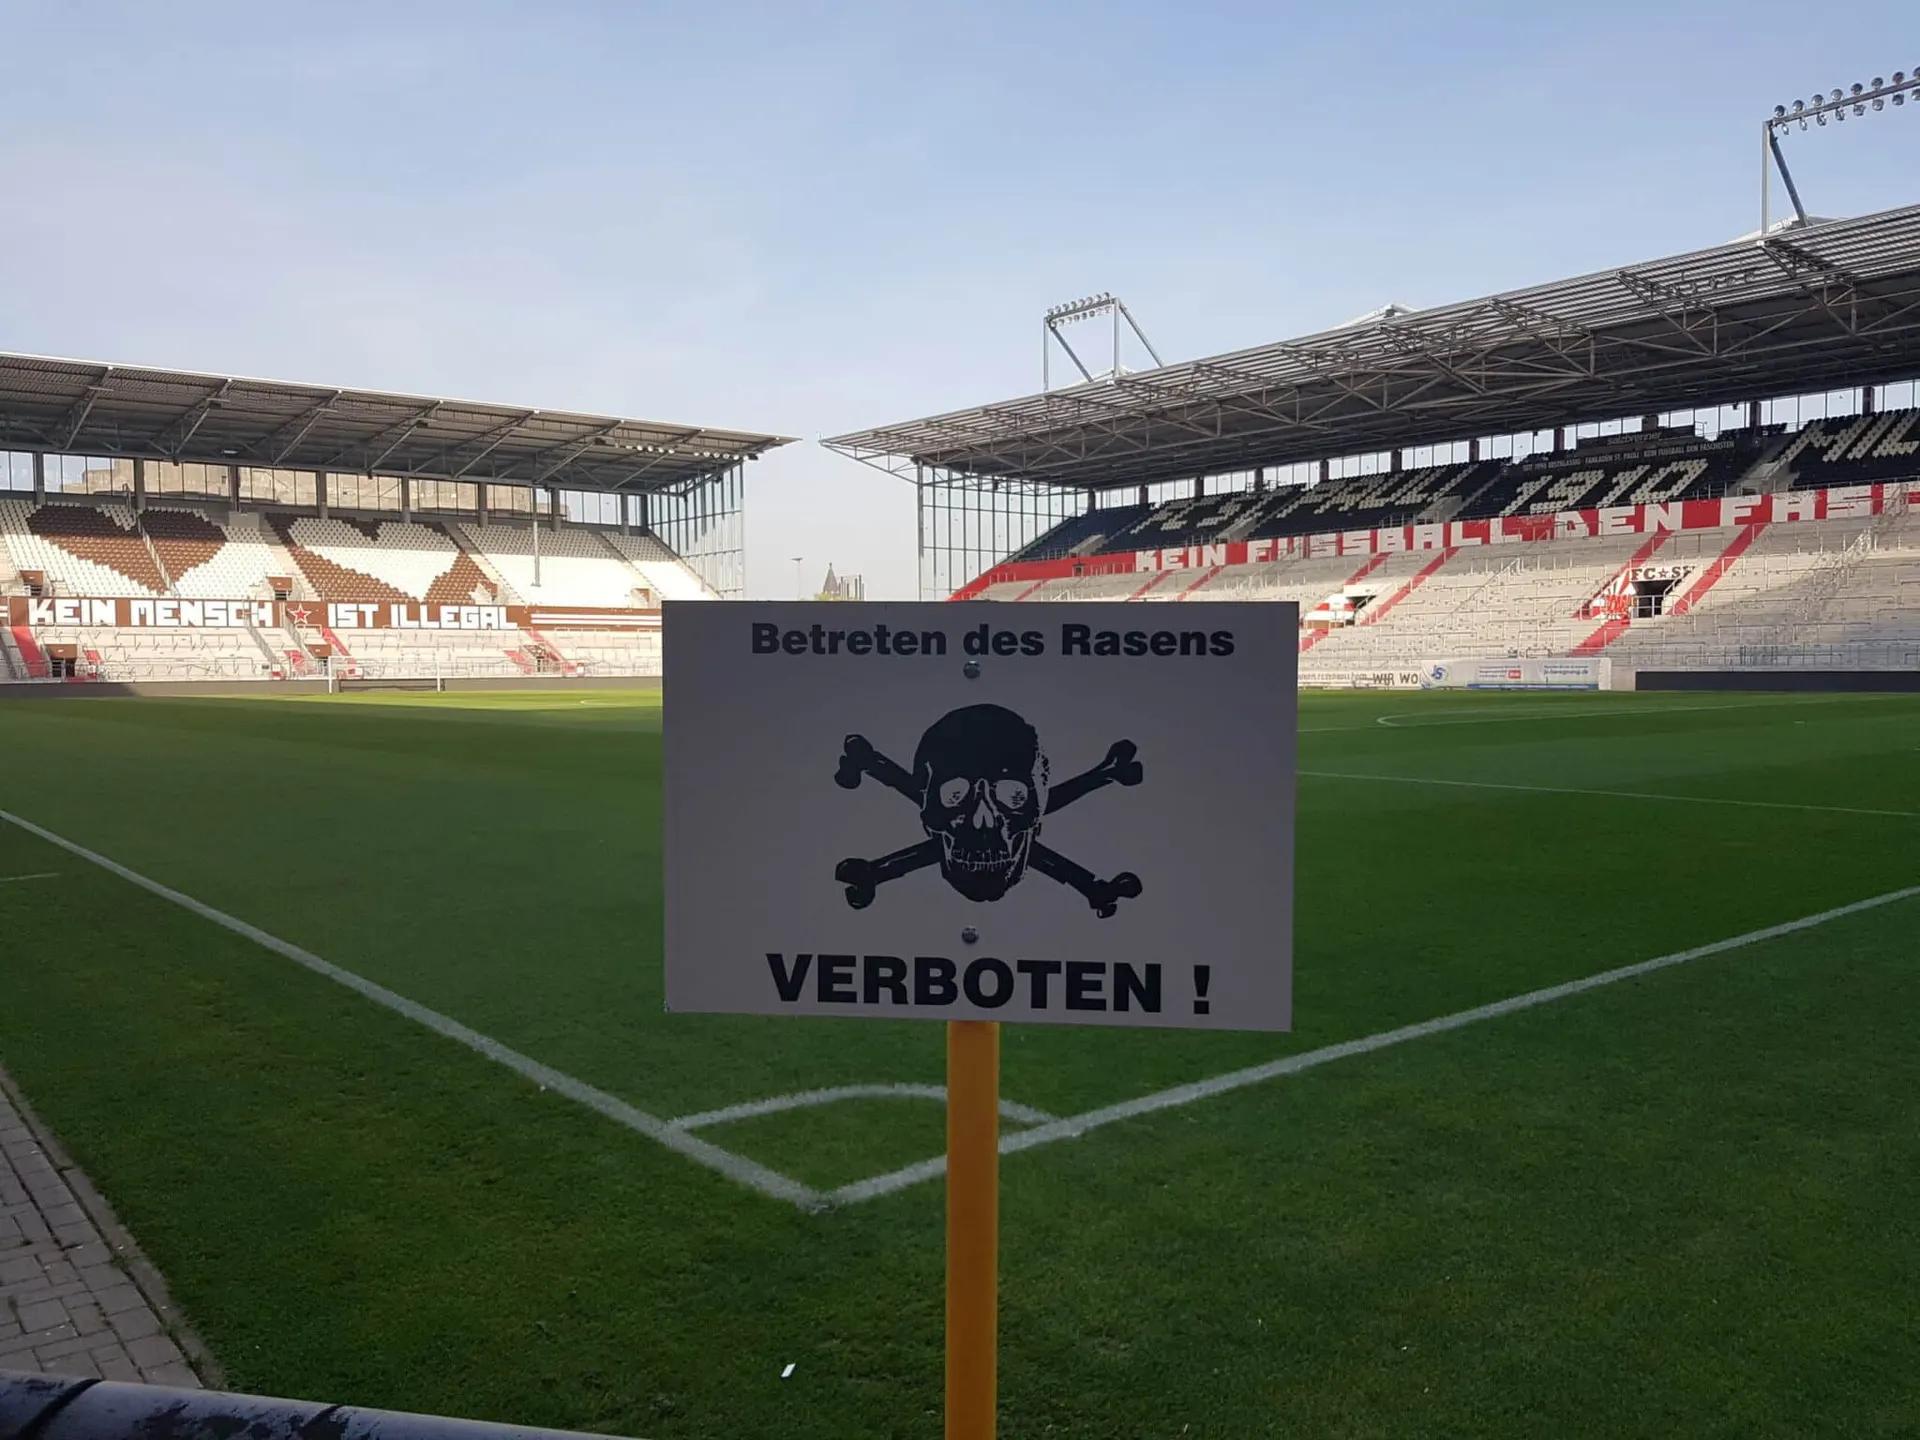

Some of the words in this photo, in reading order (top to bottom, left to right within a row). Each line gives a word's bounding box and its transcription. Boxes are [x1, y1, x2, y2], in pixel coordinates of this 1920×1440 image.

[1136, 543, 1226, 572] KEIN
[1246, 517, 1523, 563] FUSSBALL
[1631, 568, 1656, 581] FC
[29, 599, 116, 626] KEIN
[130, 600, 273, 628] MENSCH
[328, 602, 379, 629] IST
[391, 603, 518, 631] ILLEGAL
[752, 622, 947, 656] Betreten
[963, 624, 1044, 656] des
[1061, 624, 1235, 657] Rasens
[1373, 672, 1394, 685] WIR
[767, 953, 1162, 1012] VERBOTEN
[1193, 965, 1210, 1014] !
